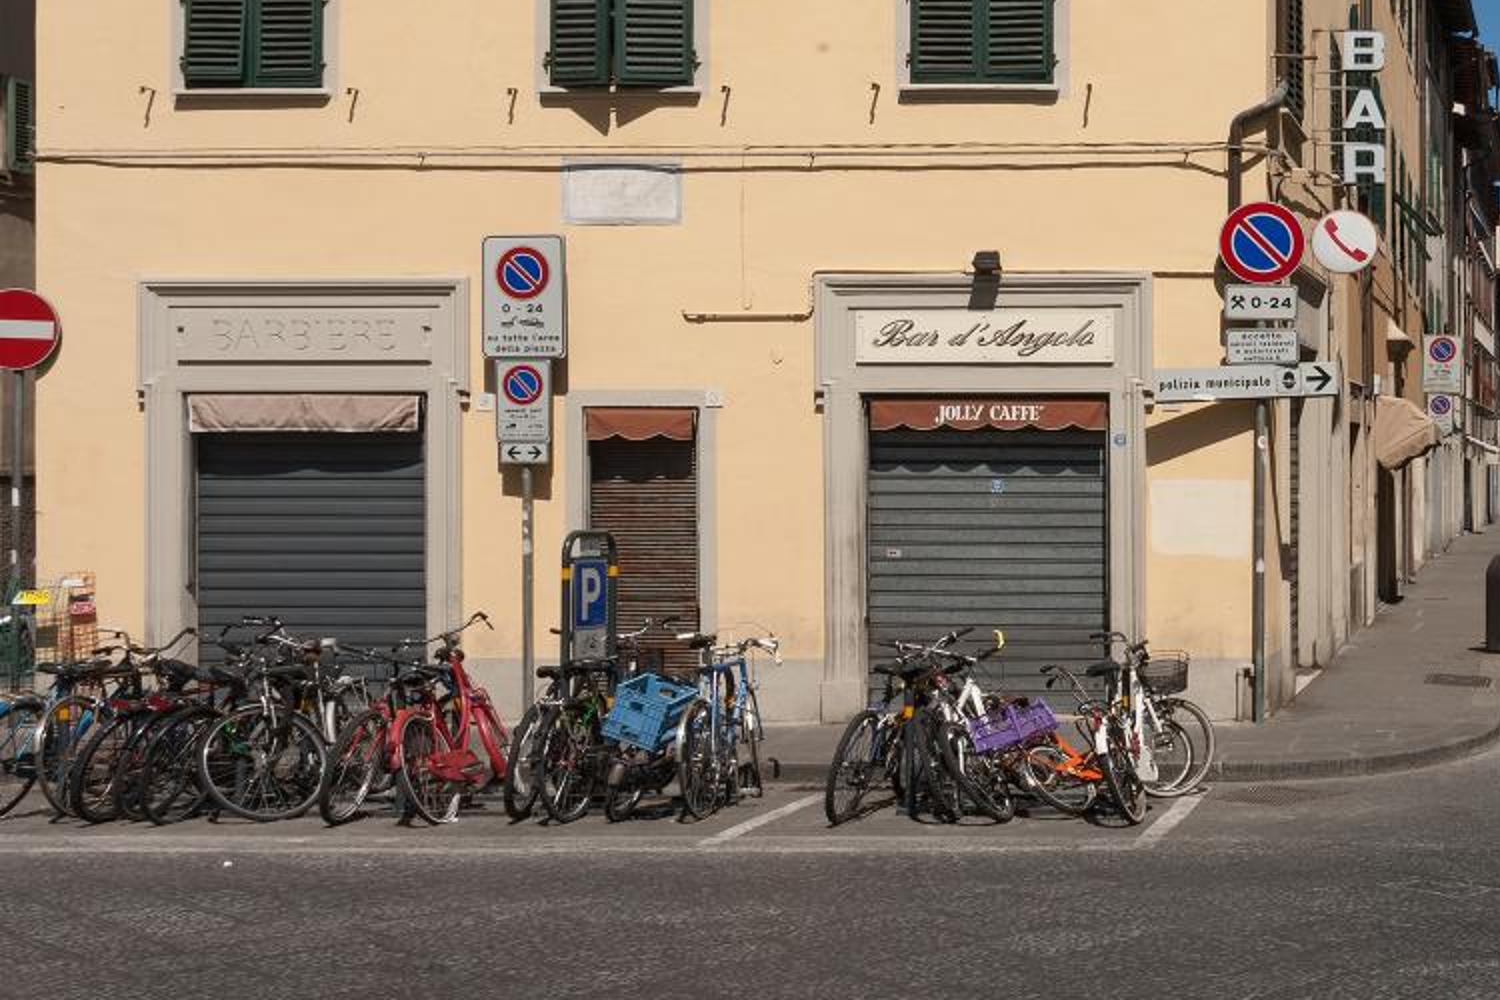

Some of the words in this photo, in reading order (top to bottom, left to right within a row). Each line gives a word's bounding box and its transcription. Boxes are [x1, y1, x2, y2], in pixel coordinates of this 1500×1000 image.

[1343, 29, 1386, 184] BAR
[1251, 297, 1292, 309] 0-24
[212, 316, 396, 351] BARBIERE
[872, 319, 939, 347] Bar
[947, 319, 1095, 357] d'Angolo
[1159, 378, 1201, 392] polizia
[1206, 375, 1272, 390] municipale
[934, 405, 985, 424] JOLLY
[581, 567, 601, 621] P
